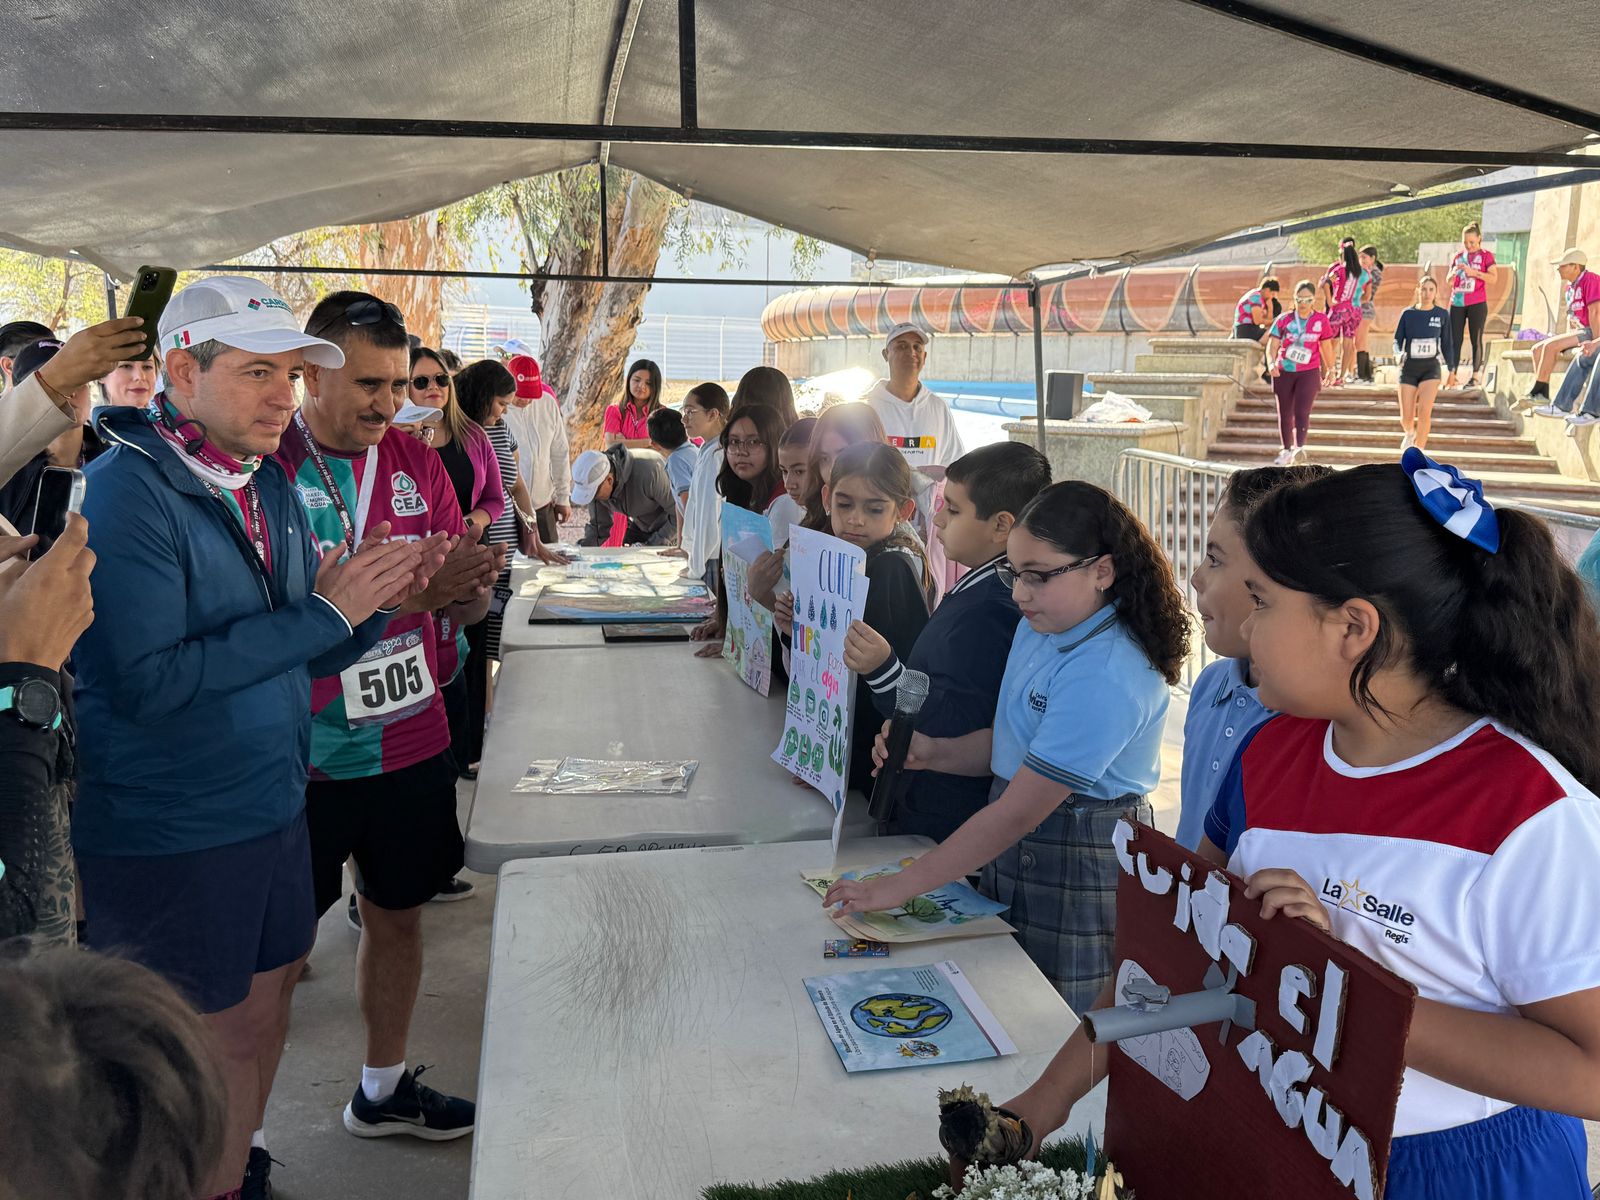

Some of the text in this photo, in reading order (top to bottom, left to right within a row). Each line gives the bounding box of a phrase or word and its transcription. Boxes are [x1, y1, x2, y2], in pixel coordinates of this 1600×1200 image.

[394, 497, 424, 510] CEA
[792, 620, 822, 661] TIPS
[358, 655, 424, 709] 505
[1322, 878, 1415, 926] La Salle
[1385, 929, 1409, 944] Regis
